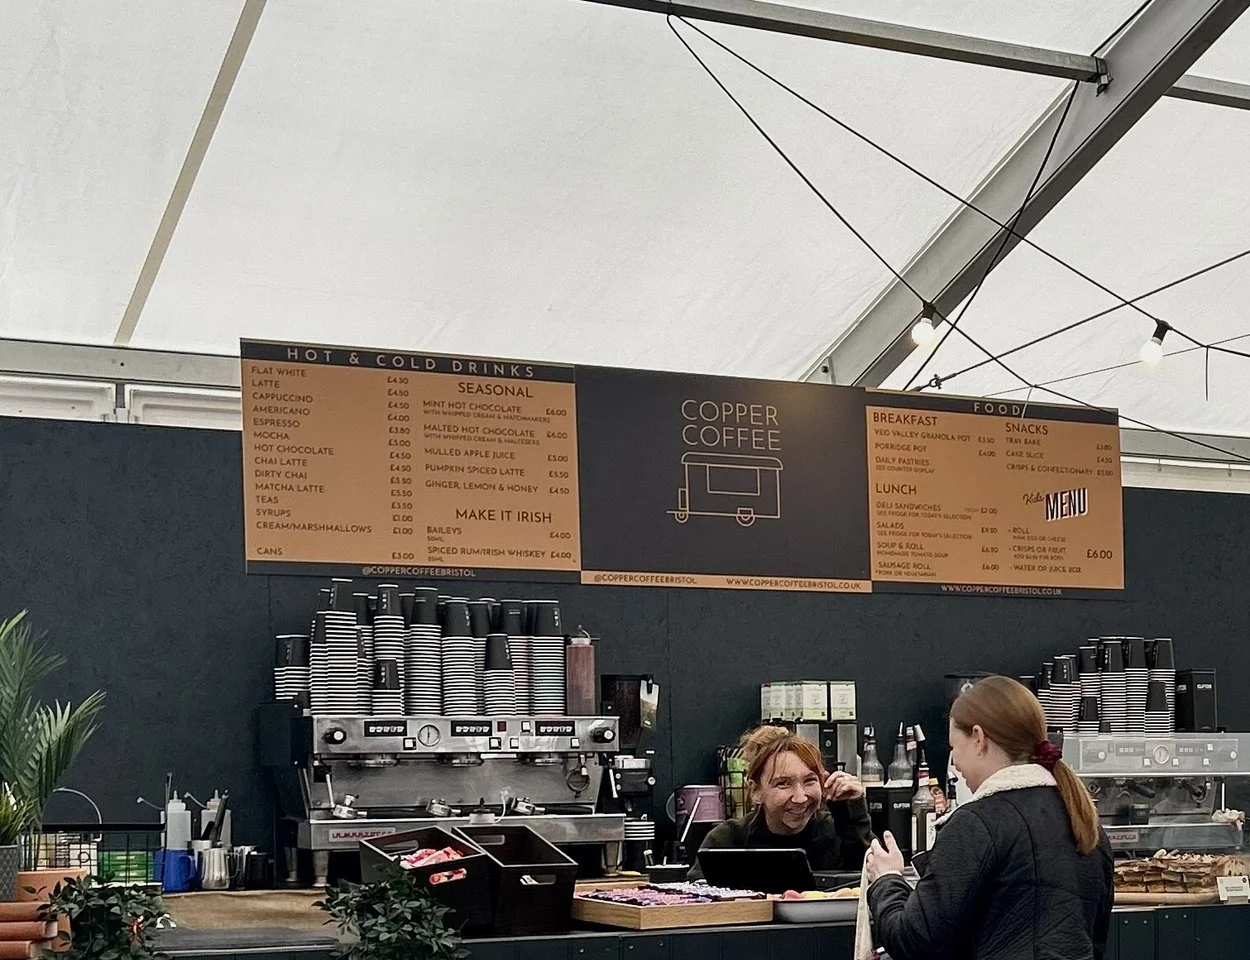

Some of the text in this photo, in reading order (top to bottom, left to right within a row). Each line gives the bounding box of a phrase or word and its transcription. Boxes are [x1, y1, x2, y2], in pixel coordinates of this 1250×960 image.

[288, 348, 533, 377] HOT & COLD DRINKS
[252, 367, 306, 377] FLAT WHITE
[252, 380, 280, 388] LATTE
[458, 382, 533, 398] SEASONAL
[252, 392, 313, 403] CAPPUCCINO
[253, 405, 310, 416] AMERICANO
[423, 400, 522, 413] MINT HOT CHOCOLATE
[974, 402, 1020, 416] FOOD
[681, 399, 779, 426] COPPER
[253, 418, 300, 427] ESPRESSO
[873, 412, 937, 426] BREAKFAST
[424, 424, 459, 432] MALTED
[483, 427, 535, 438] CHOCOLATE
[1006, 422, 1048, 435] SNACKS
[253, 431, 289, 439] MOCHA
[682, 424, 781, 450] COFFEE
[892, 431, 919, 439] VALLEY
[921, 433, 956, 441] GRANOLA
[254, 444, 334, 455] HOT CHOCOLATE
[875, 443, 911, 451] PORRIDGE
[425, 448, 515, 459] MULLED APPLE JUICE
[255, 457, 307, 466] CHAI LATTE
[876, 456, 930, 466] DAILY PASTRIES
[255, 470, 307, 479] DIRTY CHAI
[425, 464, 525, 477] PUMPKIN SPICED LATTE
[255, 483, 325, 493] MATCHA LATTE
[463, 483, 496, 491] LEMON
[507, 485, 538, 493] HONEY
[876, 482, 916, 494] LUNCH
[256, 496, 279, 504] TEAS
[1046, 488, 1088, 522] MENU
[876, 501, 941, 511] DELI SANDWICHES
[256, 509, 291, 517] SYRUPS
[456, 509, 552, 523] MAKE IT IRISH
[256, 521, 372, 533] CREAM/MARSHMALLOWS
[427, 526, 462, 535] BAILEYS
[257, 547, 283, 555] CANS
[906, 542, 924, 550] ROLL
[428, 546, 458, 555] SPICED
[508, 550, 545, 558] WHISKEY
[1087, 549, 1112, 559] £6.00
[362, 566, 476, 578] @COPPERCOFFEEBRISTOL
[594, 574, 697, 585] @COPPERCOFFEEBRISTOL
